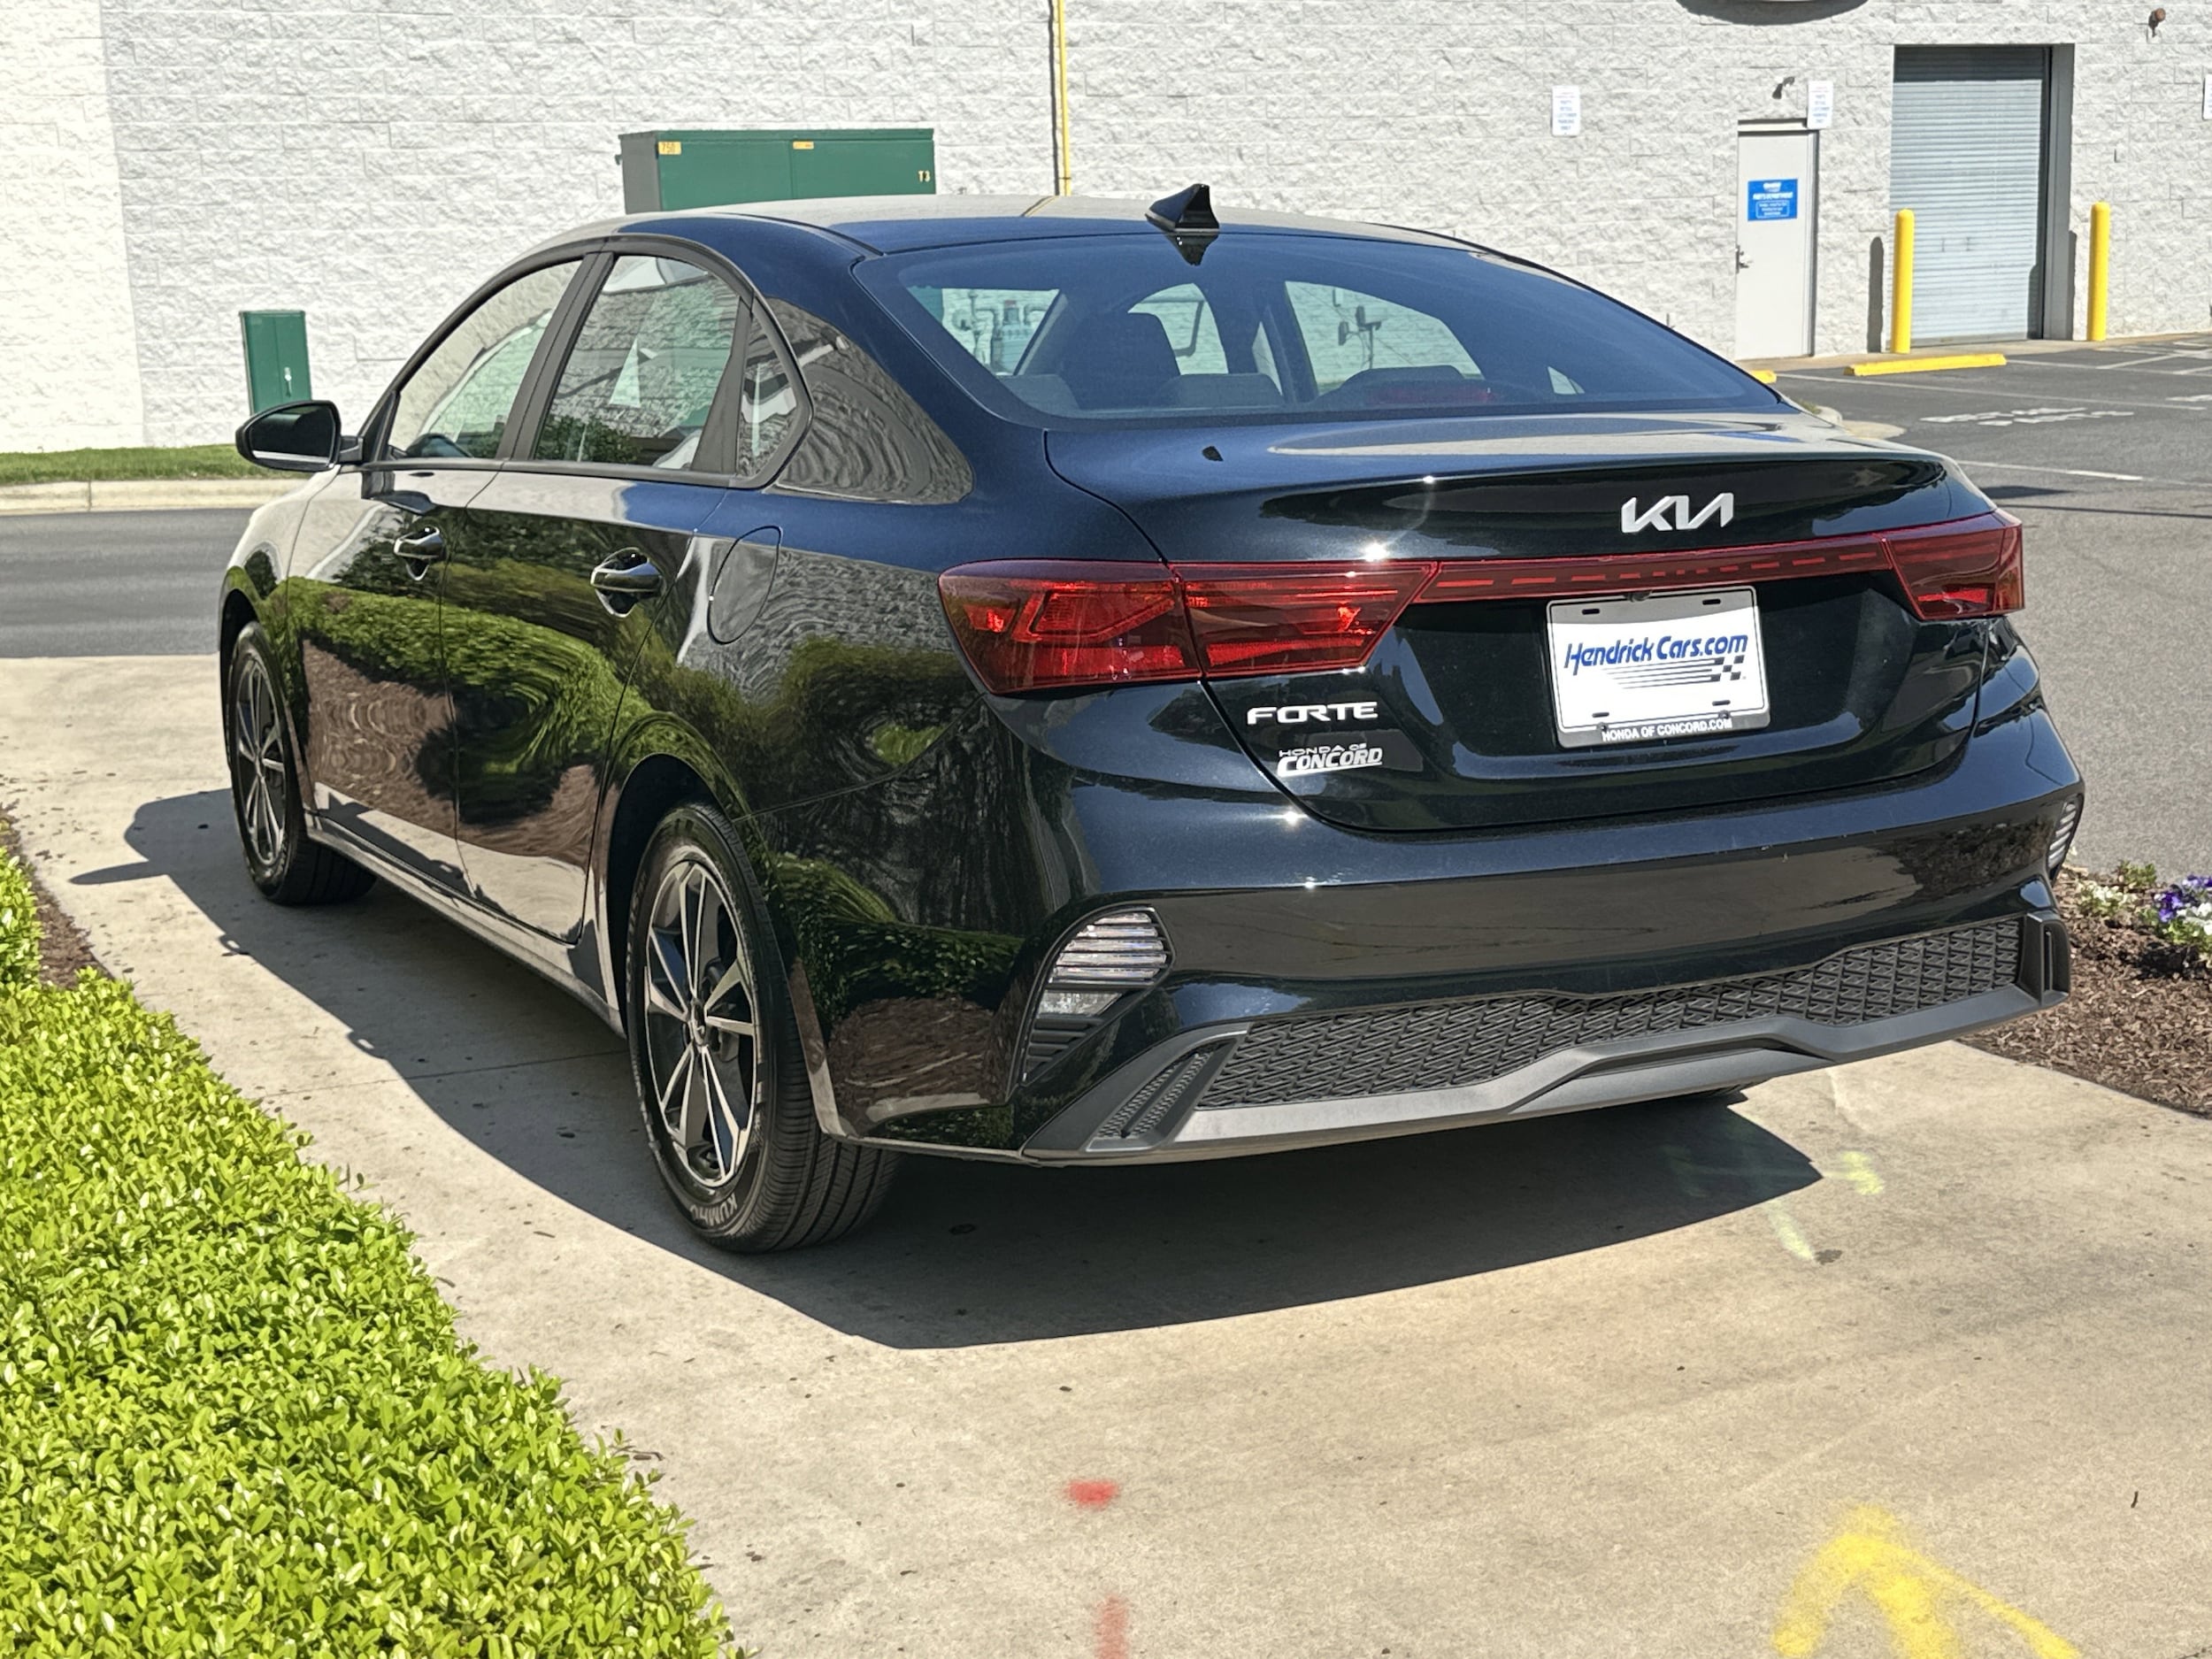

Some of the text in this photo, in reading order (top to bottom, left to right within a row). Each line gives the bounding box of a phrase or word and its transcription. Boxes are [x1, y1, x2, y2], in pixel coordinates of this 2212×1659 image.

[1622, 493, 1734, 533] KIA
[1248, 702, 1379, 725] FORTE
[1601, 718, 1733, 741] HONDA OF CONCORD.COM
[1279, 744, 1346, 757] HONDA
[1277, 747, 1383, 778] CONCORD
